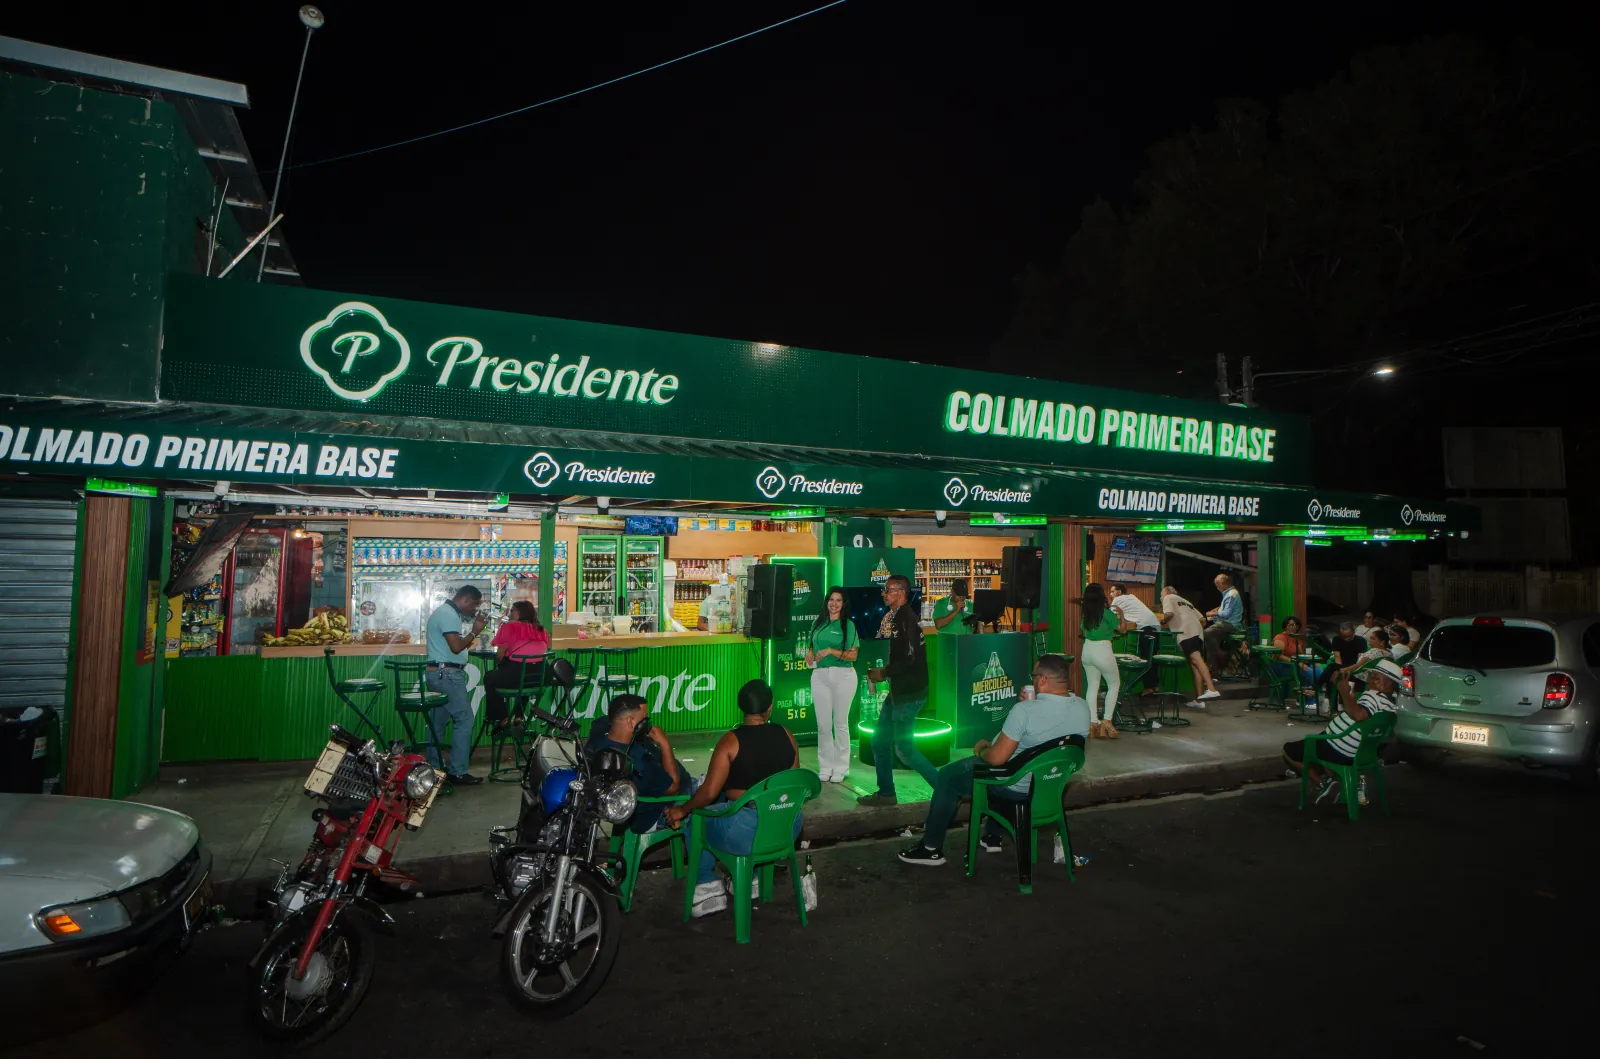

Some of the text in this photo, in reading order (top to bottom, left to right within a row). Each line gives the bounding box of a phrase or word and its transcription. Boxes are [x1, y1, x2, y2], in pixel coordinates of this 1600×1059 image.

[425, 335, 680, 406] Presidente
[946, 390, 1277, 463] COLMADO PRIMERA BASE
[154, 434, 309, 475] PRIMERA
[315, 444, 400, 480] BASE
[564, 461, 656, 485] Presidente
[788, 474, 864, 495] Presidente
[970, 484, 1032, 503] Presidente
[1098, 488, 1260, 517] COLMADO PRIMERA BASE
[1323, 504, 1361, 519] Presidente
[1414, 509, 1447, 523] Presidente
[777, 653, 793, 662] PAGA
[776, 700, 793, 709] PAGA
[971, 685, 1017, 707] FESTIVAL
